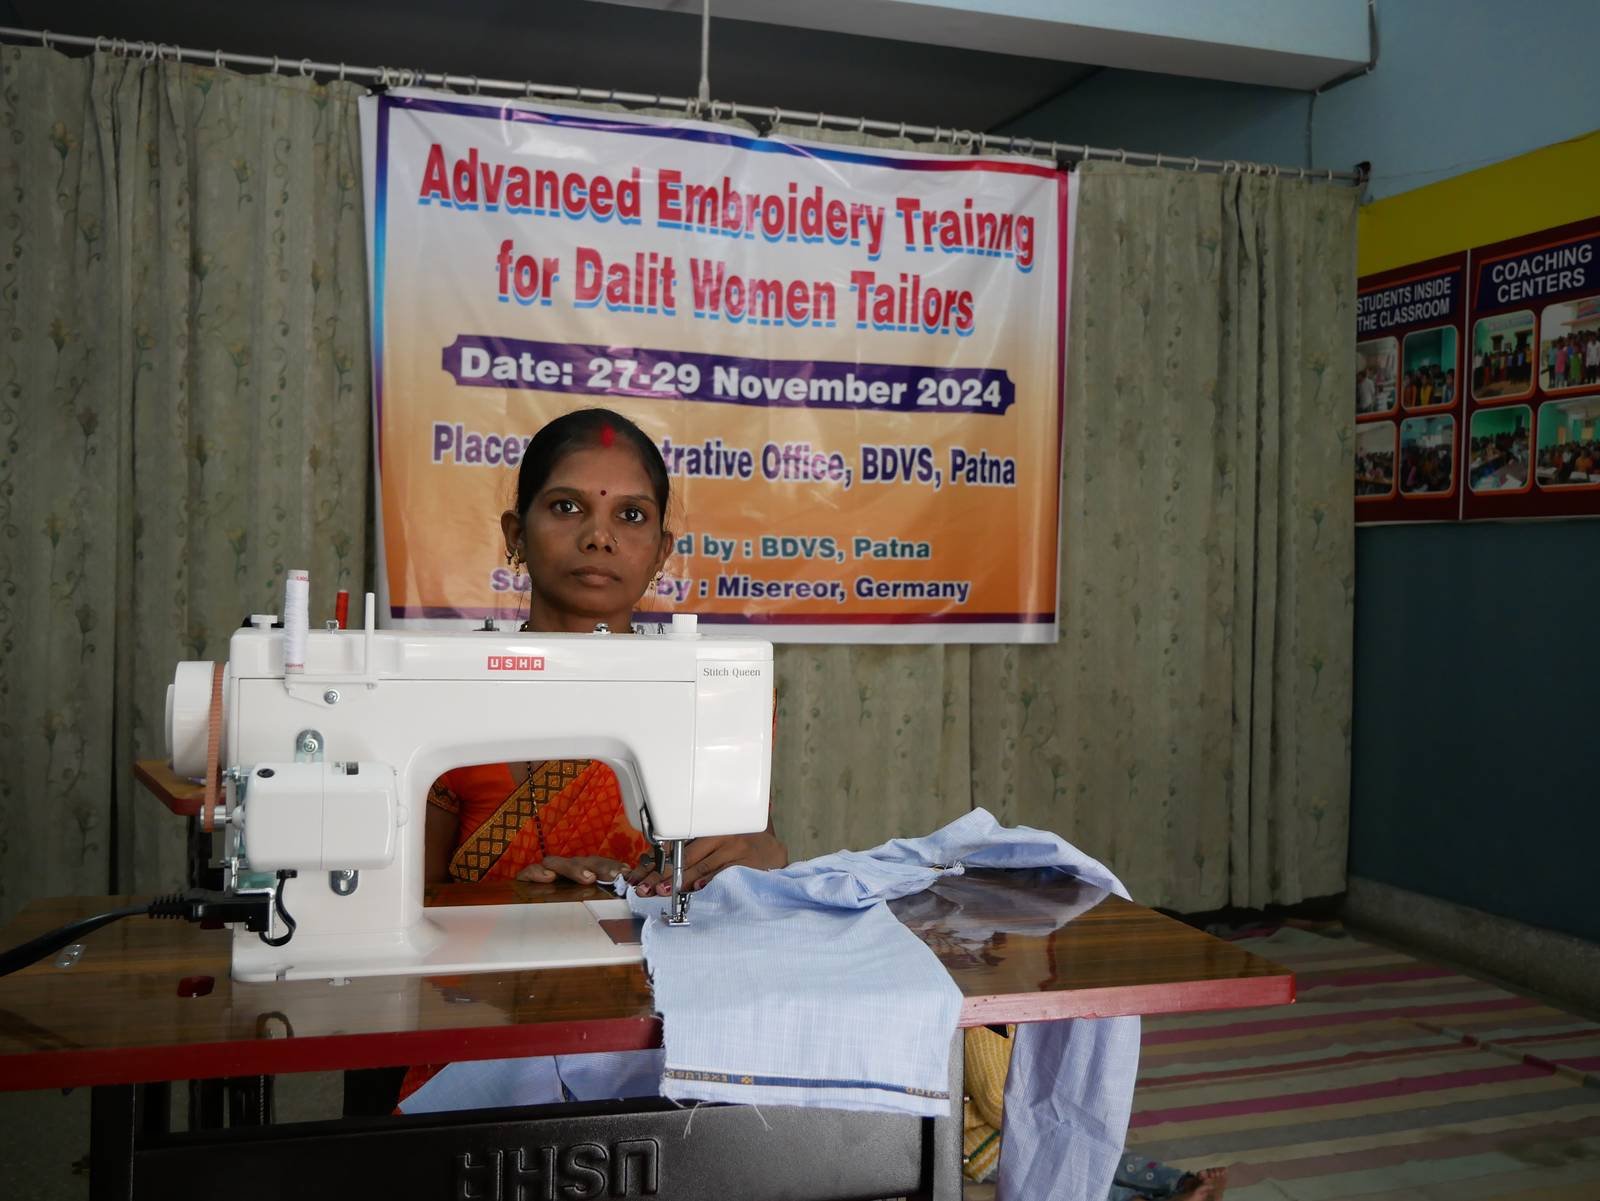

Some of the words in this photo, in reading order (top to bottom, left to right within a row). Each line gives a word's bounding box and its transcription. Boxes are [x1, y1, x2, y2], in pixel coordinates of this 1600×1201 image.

[418, 143, 642, 225] Advanced
[657, 168, 885, 262] Embroidery
[1491, 244, 1594, 284] COACHING
[496, 239, 559, 305] for
[573, 246, 677, 316] Dalit
[689, 256, 836, 328] Women
[850, 270, 975, 337] Tailors
[1356, 286, 1412, 314] STUDENTS
[1414, 276, 1451, 301] INSIDE
[1497, 268, 1585, 304] CENTERS
[1357, 313, 1377, 332] THE
[1380, 297, 1450, 328] CLASSROOM
[460, 346, 573, 386] Date:
[587, 359, 701, 394] 27-29
[713, 366, 907, 405] November
[917, 378, 1001, 407] 2024
[761, 443, 852, 488] Office,
[862, 446, 941, 489] BDVS,
[950, 448, 1016, 486] Patna
[703, 535, 735, 562] by
[761, 537, 844, 562] BDVS,
[854, 538, 931, 559] Patna
[657, 578, 691, 601] by
[717, 576, 846, 602] Misereor,
[855, 578, 969, 603] Germany
[489, 656, 544, 671] USHA
[703, 667, 729, 677] Stitch
[732, 667, 761, 678] Queen
